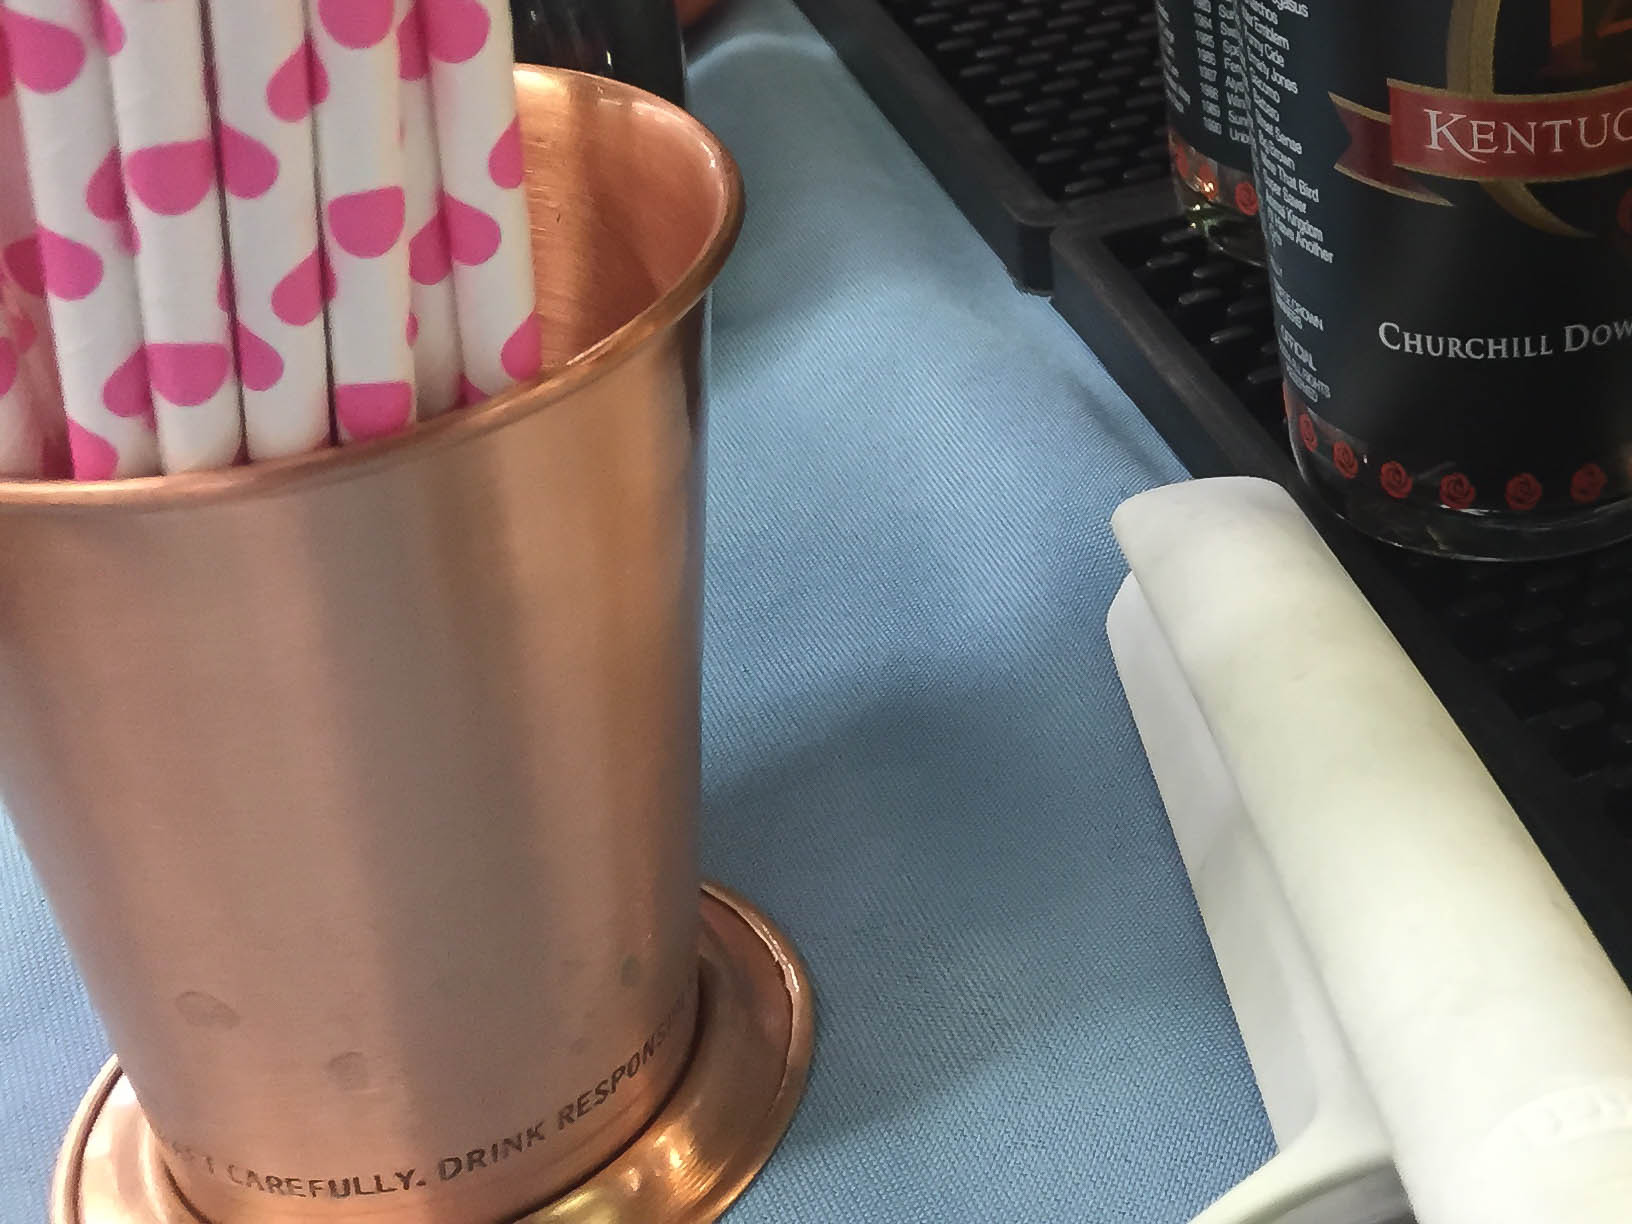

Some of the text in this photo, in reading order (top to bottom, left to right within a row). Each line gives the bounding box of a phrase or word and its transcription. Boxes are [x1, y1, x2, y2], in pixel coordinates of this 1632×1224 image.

[1378, 322, 1553, 360] CHURCHILL
[226, 1163, 427, 1199] CAREFULLY.
[437, 1121, 547, 1181] DRINK
